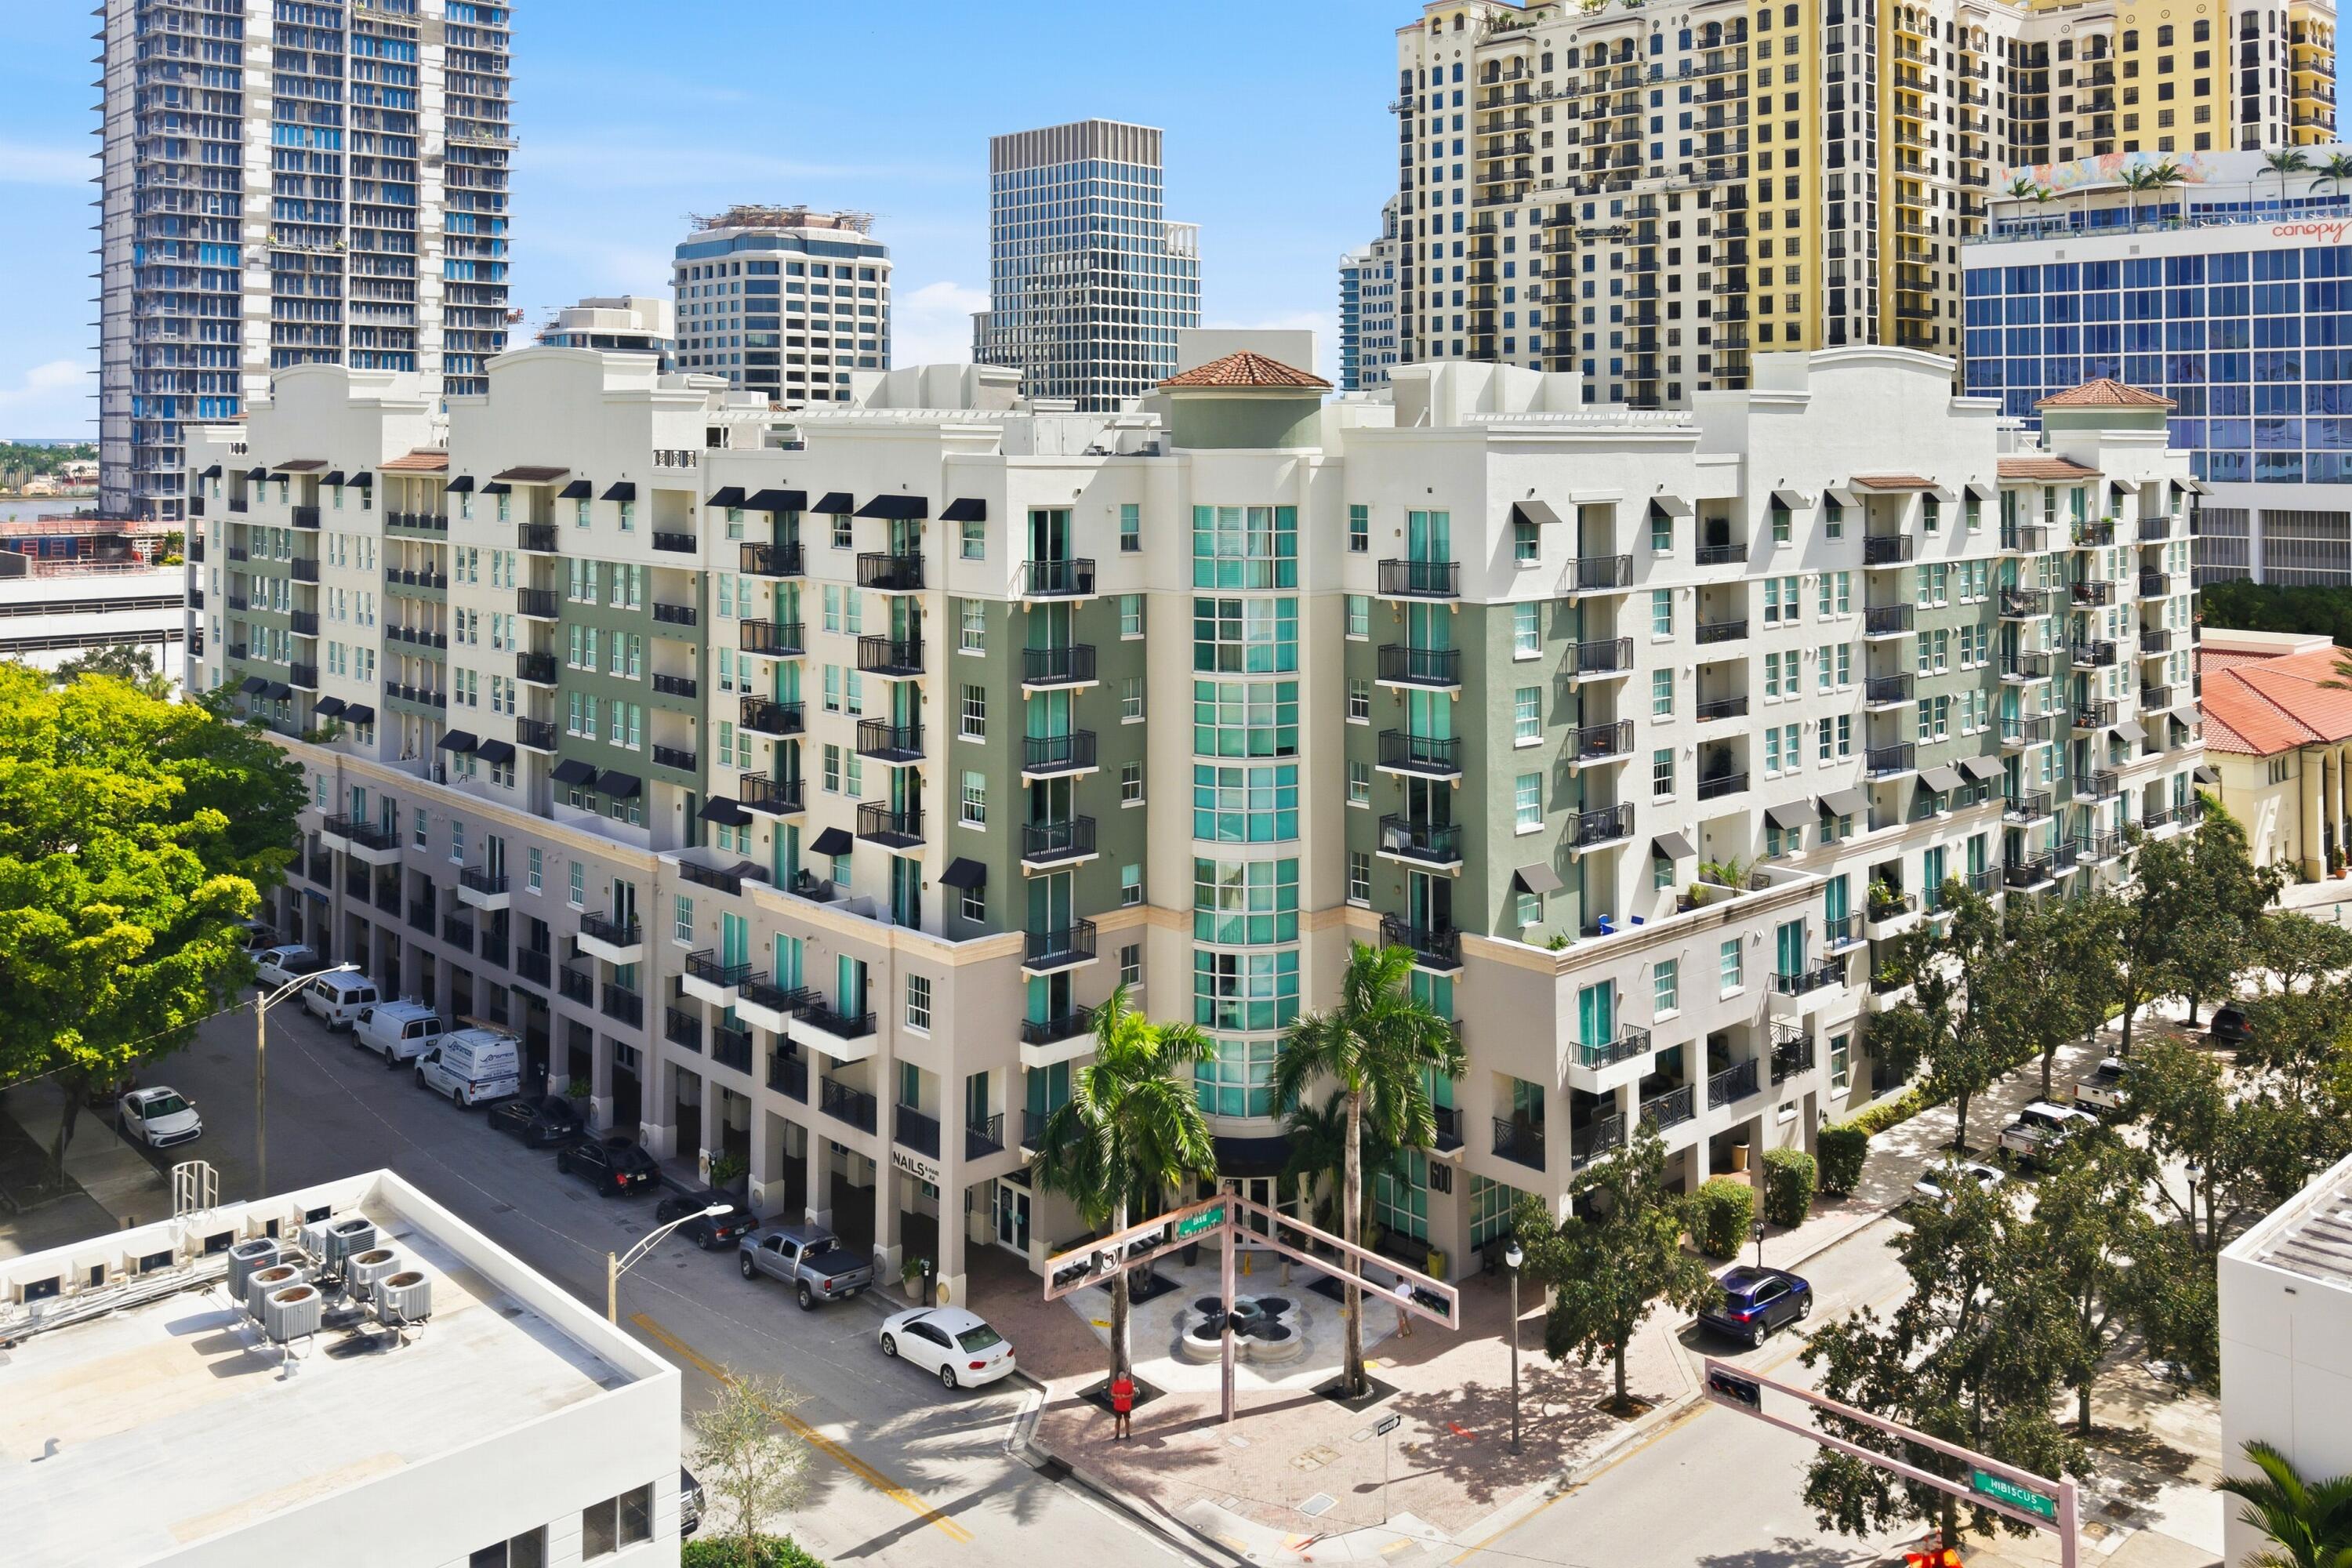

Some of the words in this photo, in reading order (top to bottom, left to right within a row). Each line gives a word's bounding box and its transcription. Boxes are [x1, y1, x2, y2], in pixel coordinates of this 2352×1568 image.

[2272, 222, 2352, 243] canopy
[893, 1150, 924, 1177] NAILS
[1430, 1160, 1452, 1194] 600
[1991, 1478, 2038, 1504] HIBISCUS
